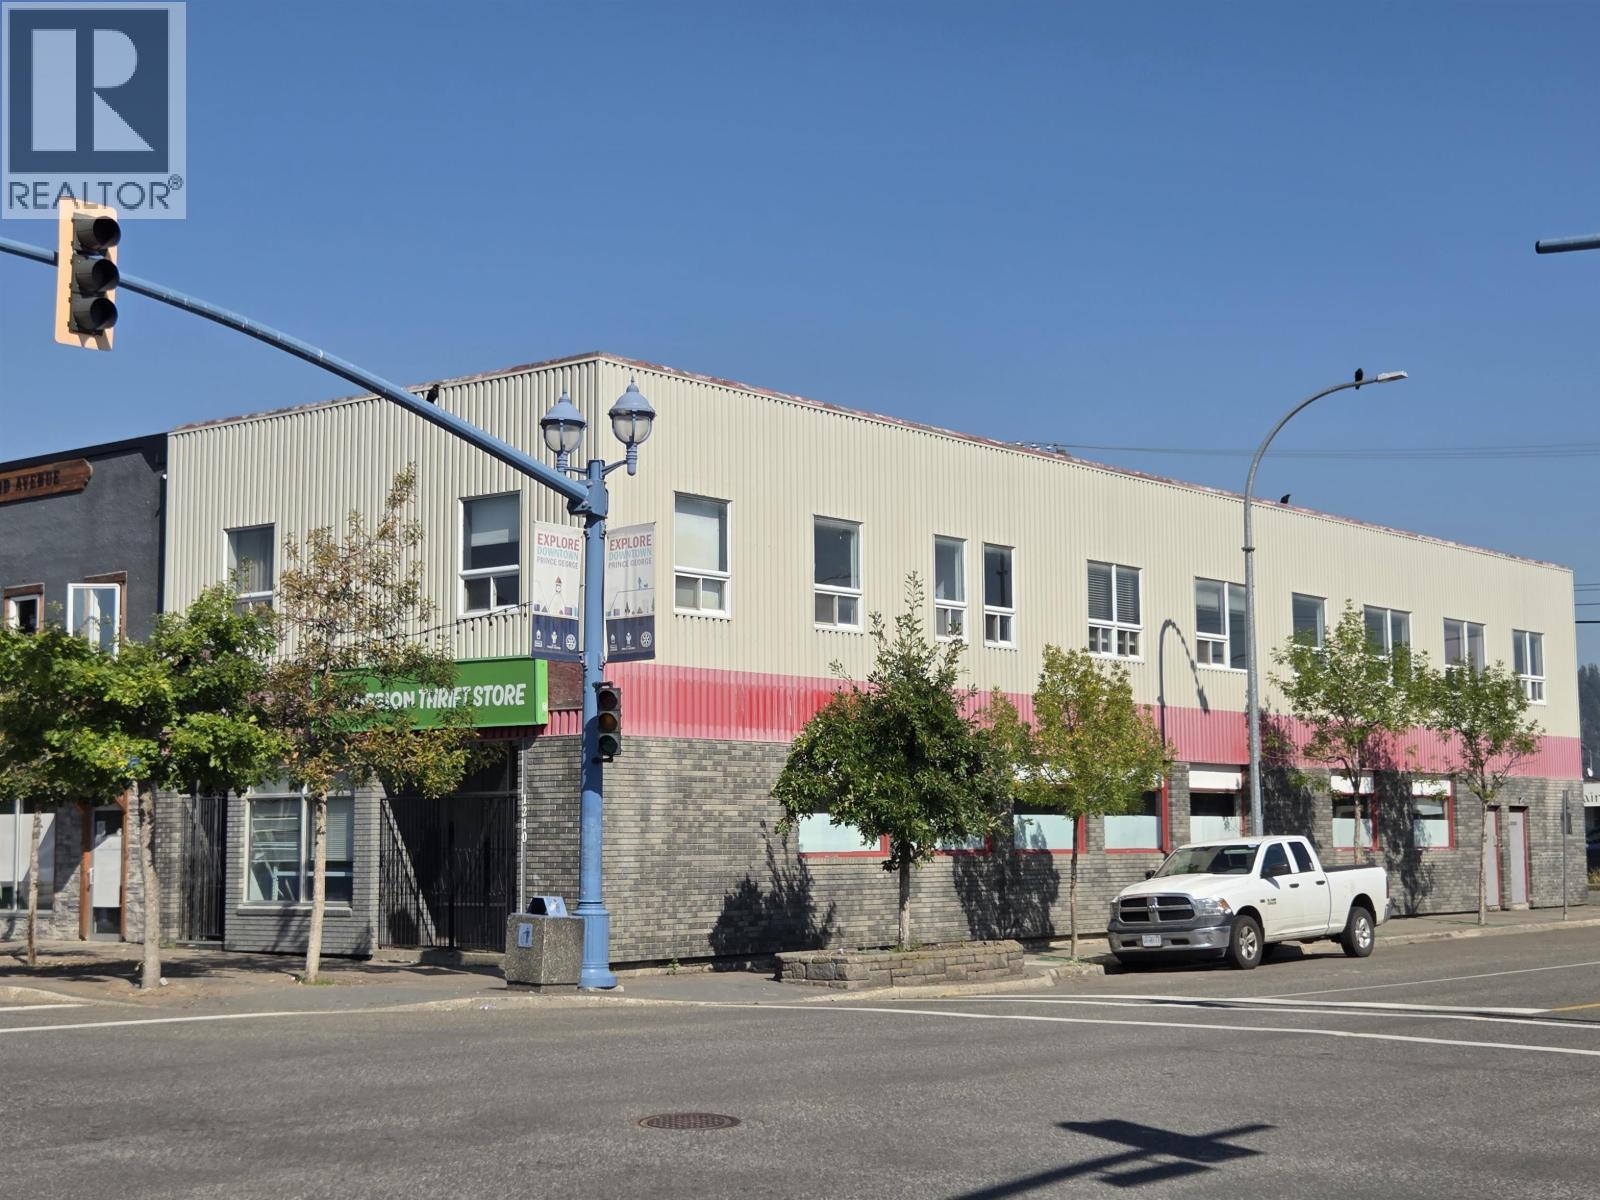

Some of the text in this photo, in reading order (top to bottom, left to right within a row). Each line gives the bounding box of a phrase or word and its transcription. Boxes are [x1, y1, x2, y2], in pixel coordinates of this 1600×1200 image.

[16, 470, 60, 491] AVENUE
[537, 533, 580, 551] EXPLORE
[610, 535, 652, 551] EXPLORE
[537, 546, 579, 560] DOWNTOWN
[608, 547, 652, 560] DOWNTOWN
[537, 556, 579, 569] PRINCE GEORGE
[608, 557, 652, 569] PRINCE GEORGE
[418, 686, 471, 709] THRIFT
[473, 684, 526, 707] STORE
